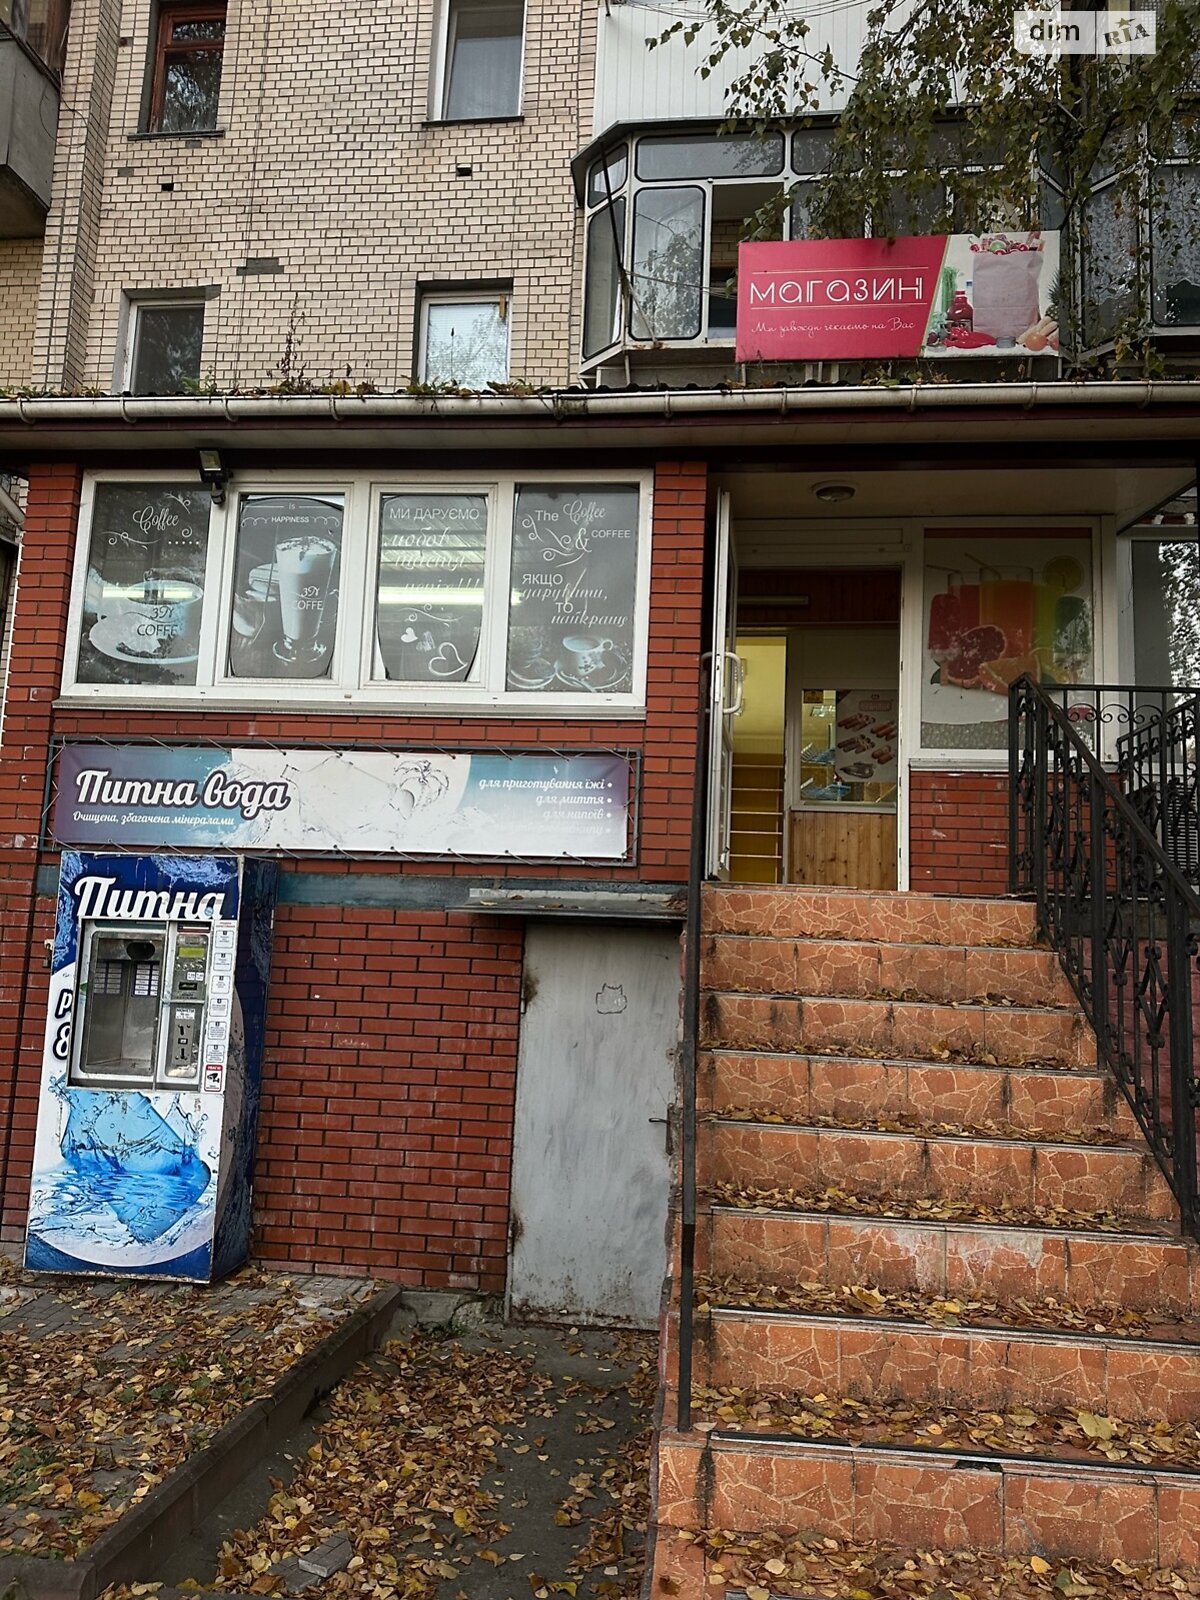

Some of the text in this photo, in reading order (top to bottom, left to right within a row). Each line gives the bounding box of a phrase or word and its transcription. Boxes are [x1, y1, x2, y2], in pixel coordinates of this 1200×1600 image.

[751, 321, 776, 333] Ми
[888, 317, 916, 332] Вас
[132, 505, 180, 534] Coffee
[389, 508, 480, 521] МИ ДАРУЄМО
[534, 500, 606, 525] The Coffee
[575, 527, 631, 552] & COFFEE
[522, 573, 563, 587] ЯКЩО
[555, 602, 574, 614] ТО
[479, 777, 605, 791] для приготування їжі
[75, 769, 291, 818] Питна вода
[535, 794, 604, 806] для миття
[72, 811, 236, 827] Очищена, збагачена мінералами
[74, 876, 226, 920] Питна
